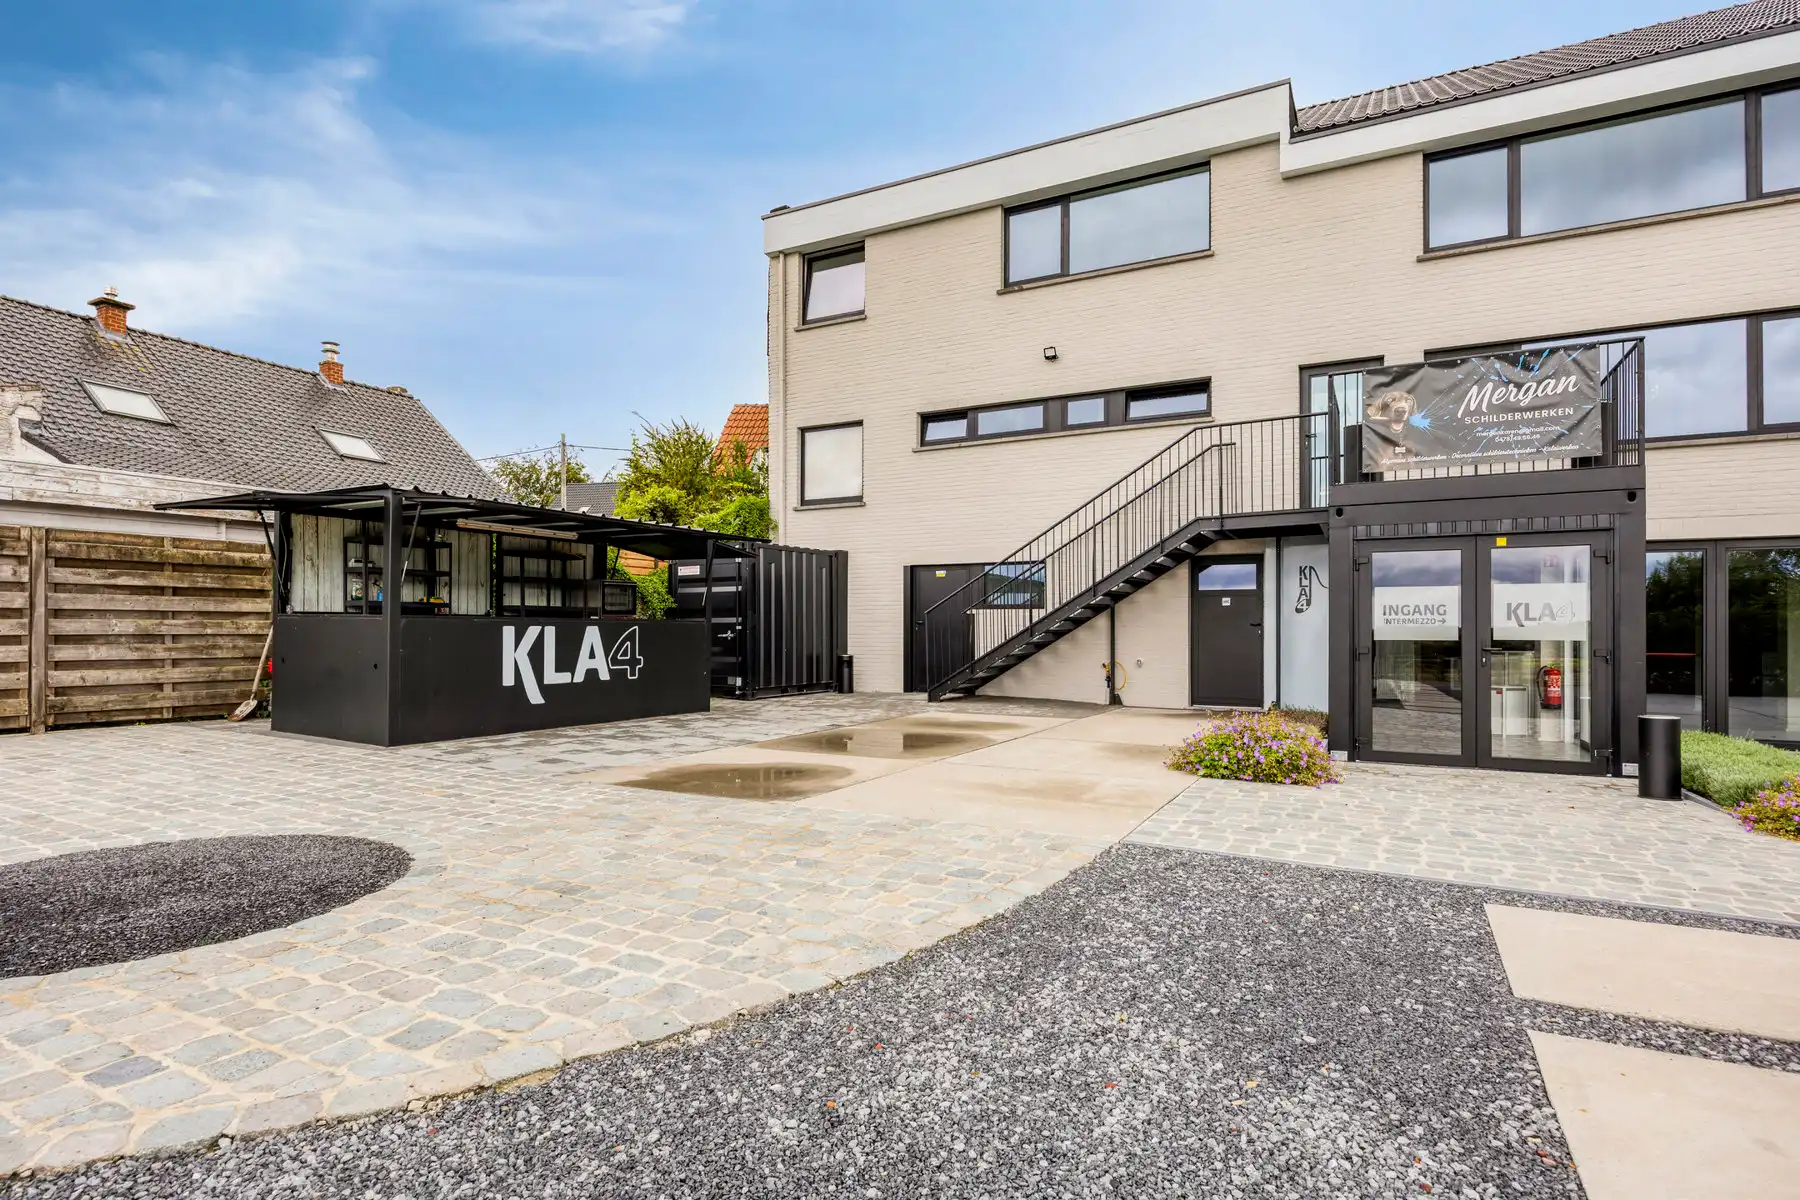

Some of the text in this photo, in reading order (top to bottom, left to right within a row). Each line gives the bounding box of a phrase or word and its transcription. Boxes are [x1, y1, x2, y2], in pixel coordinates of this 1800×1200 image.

[1457, 374, 1580, 418] Mergan
[1464, 407, 1574, 424] SCHILDERWERKEN
[1382, 604, 1447, 617] INGANG
[1384, 617, 1437, 625] INTERMEZZO
[1506, 601, 1575, 627] KLA4
[502, 625, 644, 705] KLA4
